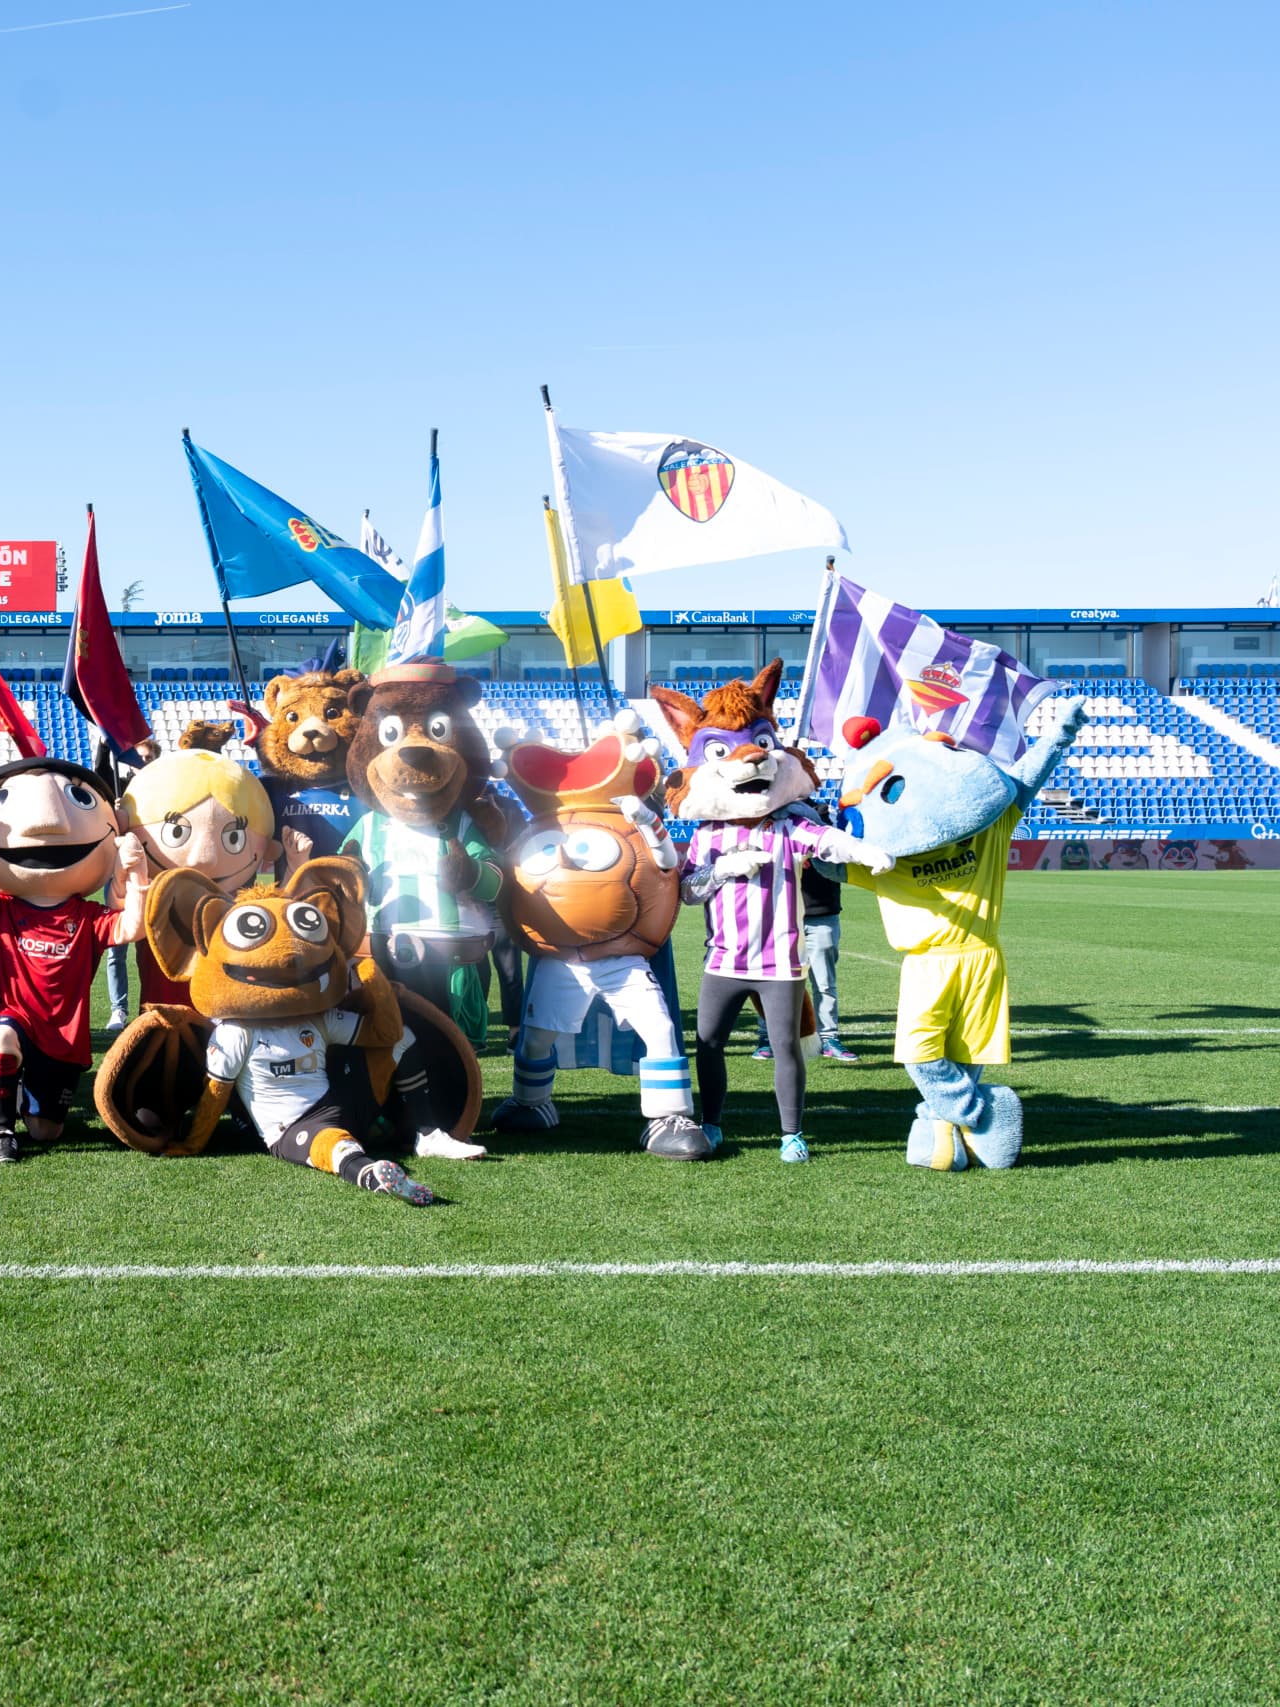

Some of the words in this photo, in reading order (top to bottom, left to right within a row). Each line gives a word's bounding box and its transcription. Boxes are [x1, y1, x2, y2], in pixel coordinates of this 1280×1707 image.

[691, 610, 749, 624] CaixaBank
[282, 803, 350, 816] ALIMERKA
[911, 849, 977, 878] PAMESA
[272, 1063, 291, 1076] TM
